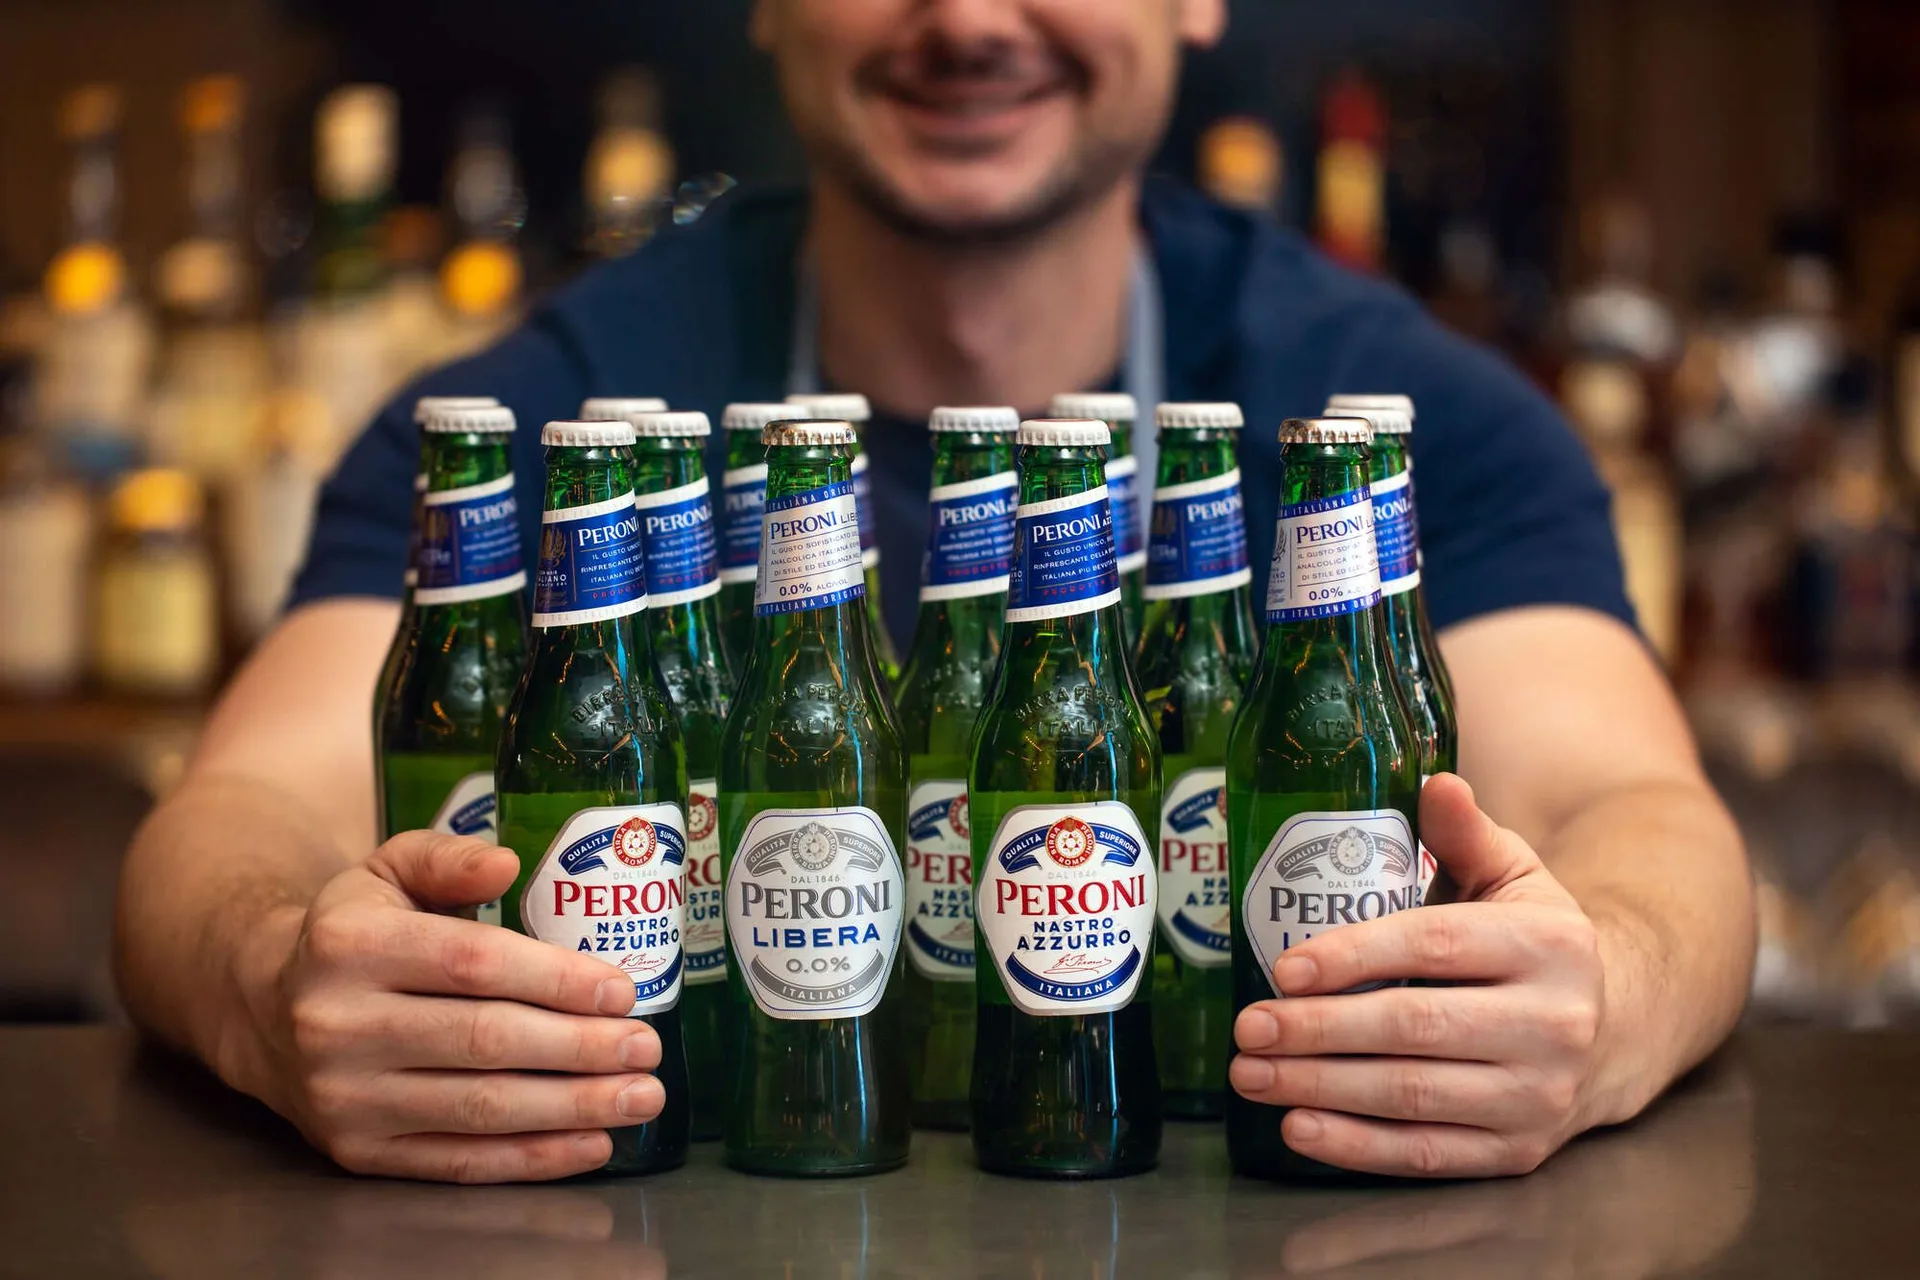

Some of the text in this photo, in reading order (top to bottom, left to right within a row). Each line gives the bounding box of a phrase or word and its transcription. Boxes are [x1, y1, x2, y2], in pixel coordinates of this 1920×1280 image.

[940, 498, 1006, 527] PERONI
[1293, 498, 1346, 516] ITALIANA
[1373, 497, 1408, 521] RONI
[770, 511, 837, 540] PERONI
[1032, 514, 1101, 544] PERONI
[1296, 515, 1364, 544] PERONI
[778, 544, 804, 554] GUSTO
[1053, 545, 1082, 556] GUSTO
[1306, 548, 1334, 558] GUSTO
[770, 553, 817, 566] ANALCOLICA
[1033, 555, 1088, 570] RINFRESCANTE
[782, 567, 802, 576] STILE
[805, 563, 816, 571] ED
[1041, 570, 1077, 581] ITALIANA
[1312, 571, 1334, 579] STILE
[780, 582, 812, 597] 0.0%
[1309, 587, 1344, 601] 0.0%
[1292, 602, 1347, 618] ITALIANA
[567, 834, 609, 862] QUALITÀ
[615, 827, 627, 856] BIRRA
[1005, 830, 1138, 860] QUALITÀ SUPERIORE
[1049, 824, 1093, 856] BIRRA PERONI
[750, 836, 881, 863] QUALITÀ SUPERIORE
[1283, 842, 1324, 868] QUALITÀ
[624, 857, 649, 866] ROMA
[801, 860, 829, 871] ROMA
[906, 847, 972, 885] PER
[1058, 856, 1086, 867] ROMA
[791, 874, 840, 884] DAL 1846
[1328, 880, 1376, 889] DAL 1846
[689, 890, 721, 905] STR
[740, 879, 893, 920] PERONI
[995, 874, 1145, 916] PERONI
[1269, 885, 1413, 924] PERONI
[597, 916, 669, 934] NASTRO
[1034, 917, 1114, 933] NASTRO
[577, 928, 680, 952] AZZURRO
[753, 922, 881, 948] LIBERA
[1017, 929, 1131, 950] AZZURRO
[786, 956, 851, 973] 0.0%
[637, 979, 668, 997] IANA
[782, 985, 858, 1001] ITALIANA
[1039, 980, 1114, 997] ITALIANA
